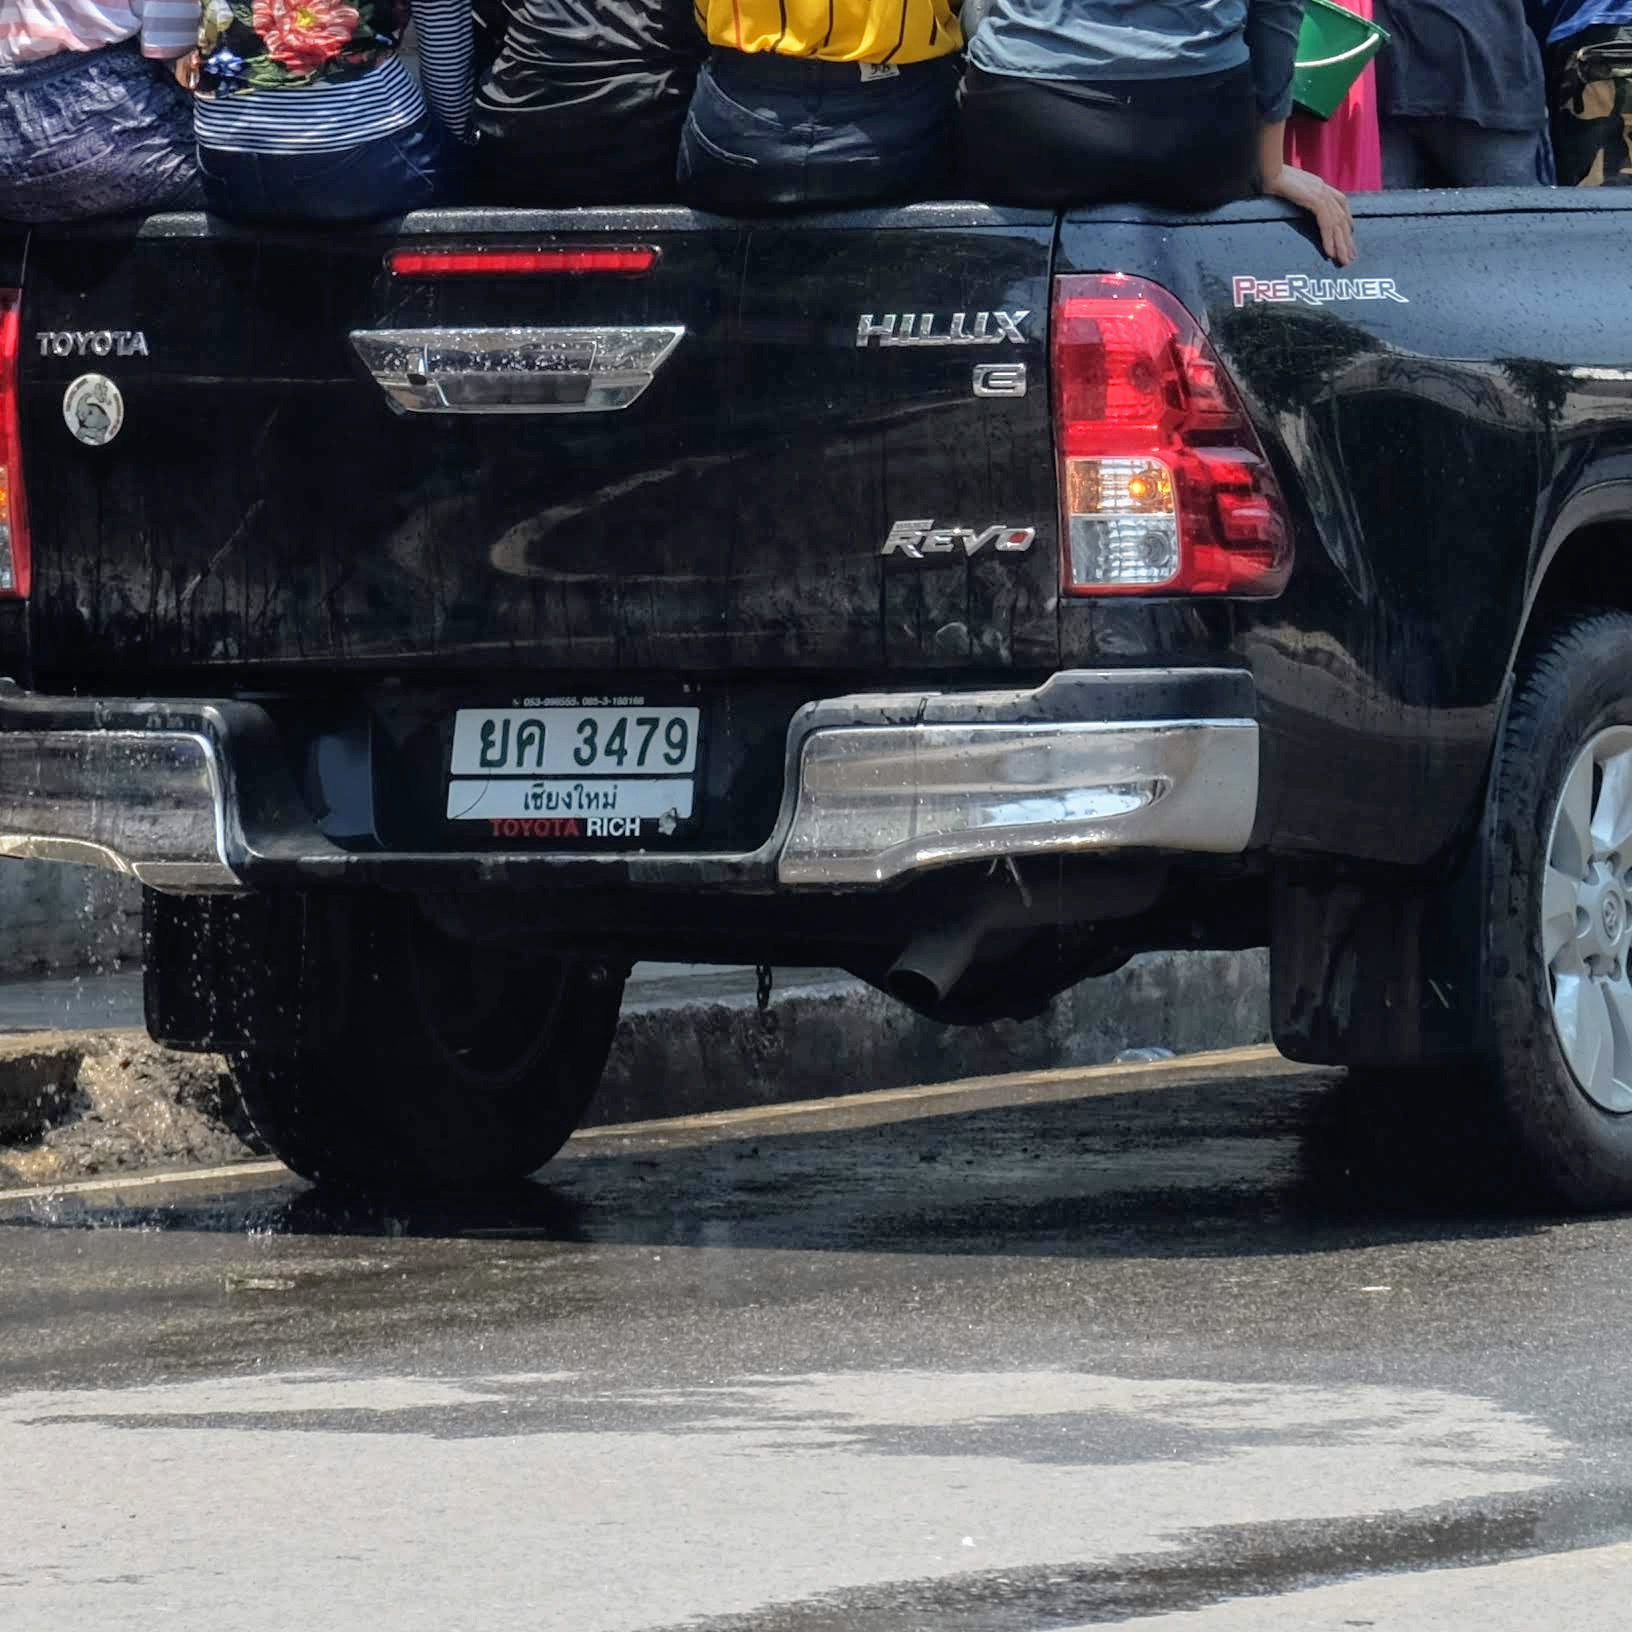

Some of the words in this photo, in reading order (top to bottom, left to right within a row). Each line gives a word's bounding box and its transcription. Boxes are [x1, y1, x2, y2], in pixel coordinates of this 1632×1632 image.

[856, 310, 1031, 347] HILUX
[35, 331, 149, 356] TOYOTA
[479, 718, 546, 768] ยค
[573, 717, 688, 767] 3479
[524, 783, 617, 811] เชียงใหม่
[491, 818, 579, 837] TOYOTA
[586, 818, 640, 836] RICH
